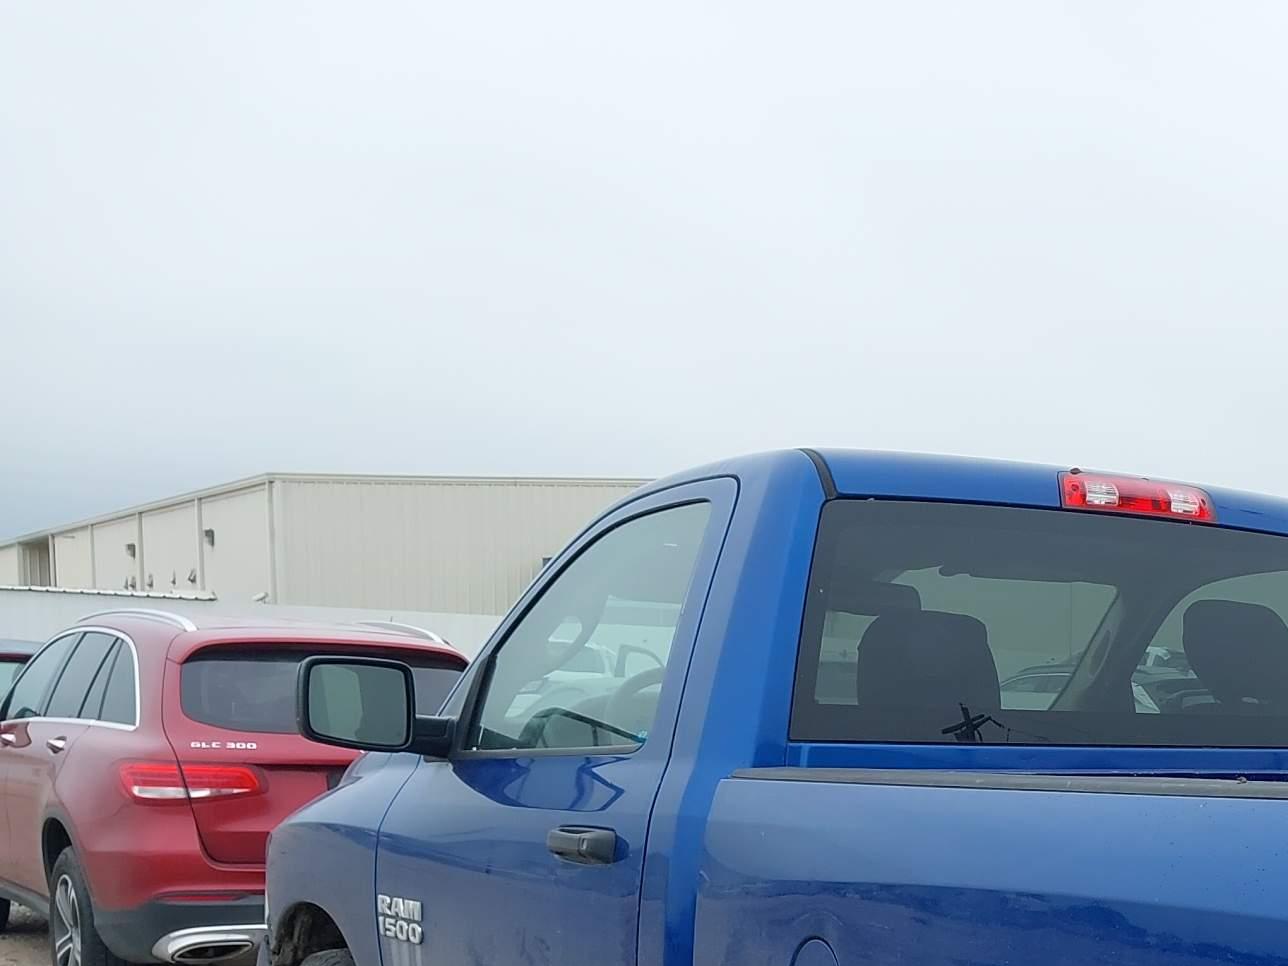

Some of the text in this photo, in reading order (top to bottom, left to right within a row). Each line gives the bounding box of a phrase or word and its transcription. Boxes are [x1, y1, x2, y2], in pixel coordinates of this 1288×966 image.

[190, 741, 257, 750] GLC 300
[377, 894, 422, 921] RAM
[378, 916, 422, 944] 1500
